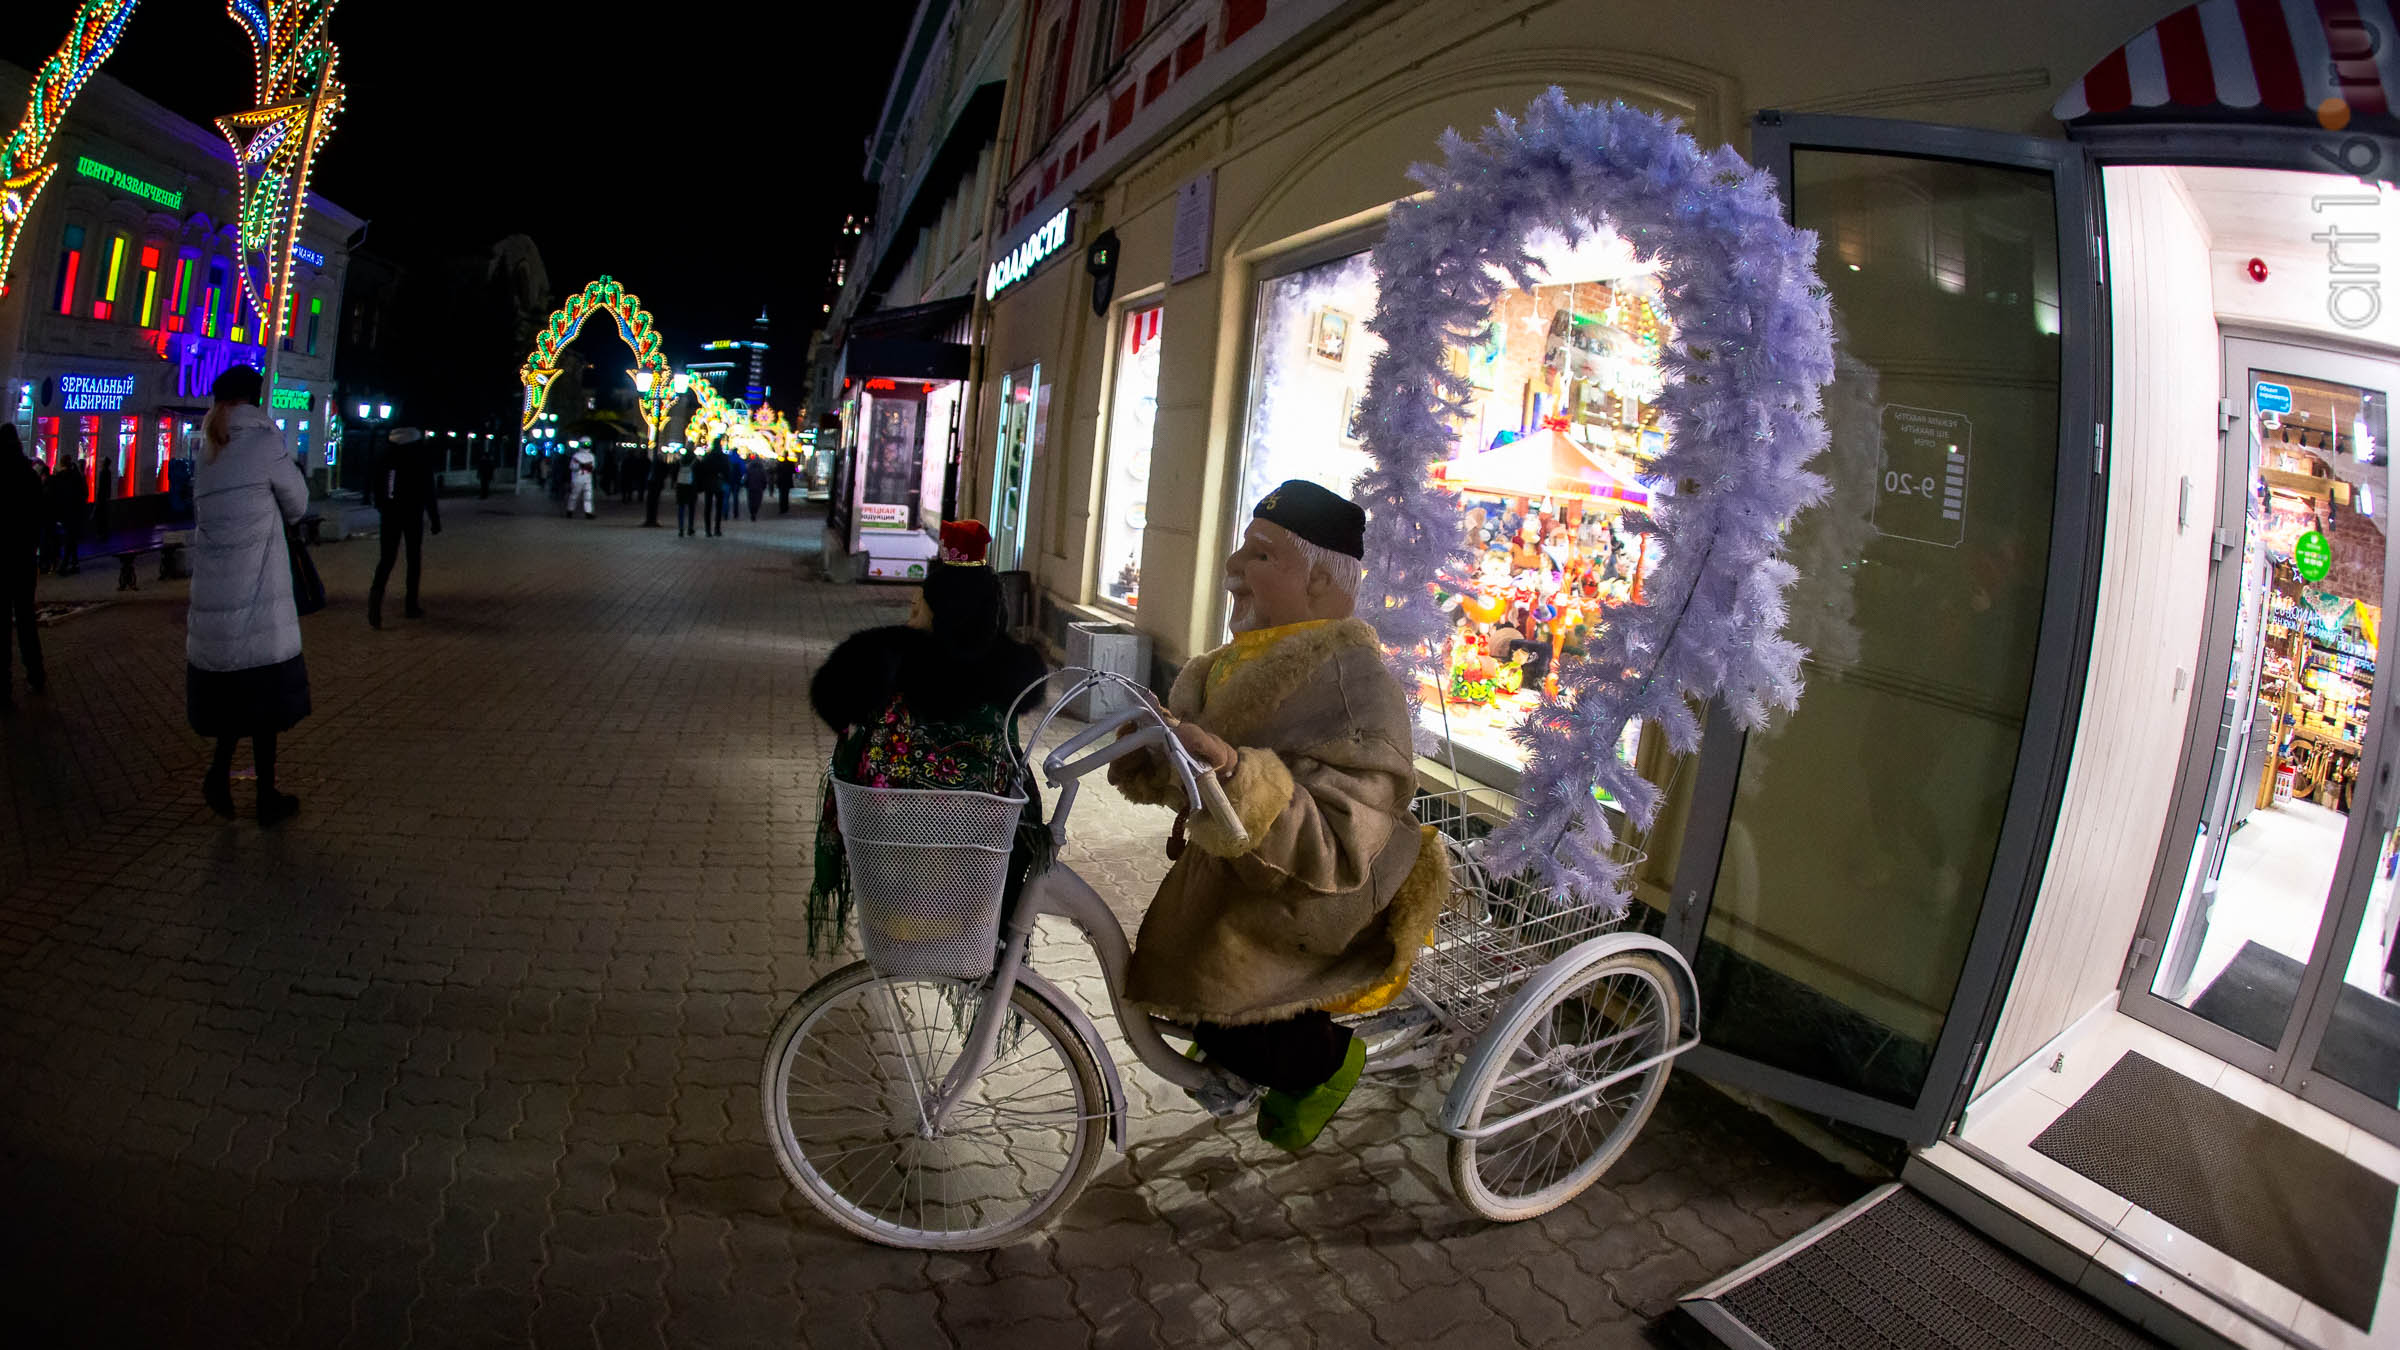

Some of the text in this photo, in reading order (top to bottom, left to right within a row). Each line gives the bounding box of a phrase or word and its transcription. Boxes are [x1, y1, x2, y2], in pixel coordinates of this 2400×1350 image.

[77, 156, 182, 210] ЦЕНТР РАЗВЛЕЧЕНИЙ
[996, 208, 1069, 291] СЛАДОСТИ
[61, 376, 134, 394] ЗЕРКАЛЬНЫЙ
[64, 394, 123, 410] ЛАБИРИНТ
